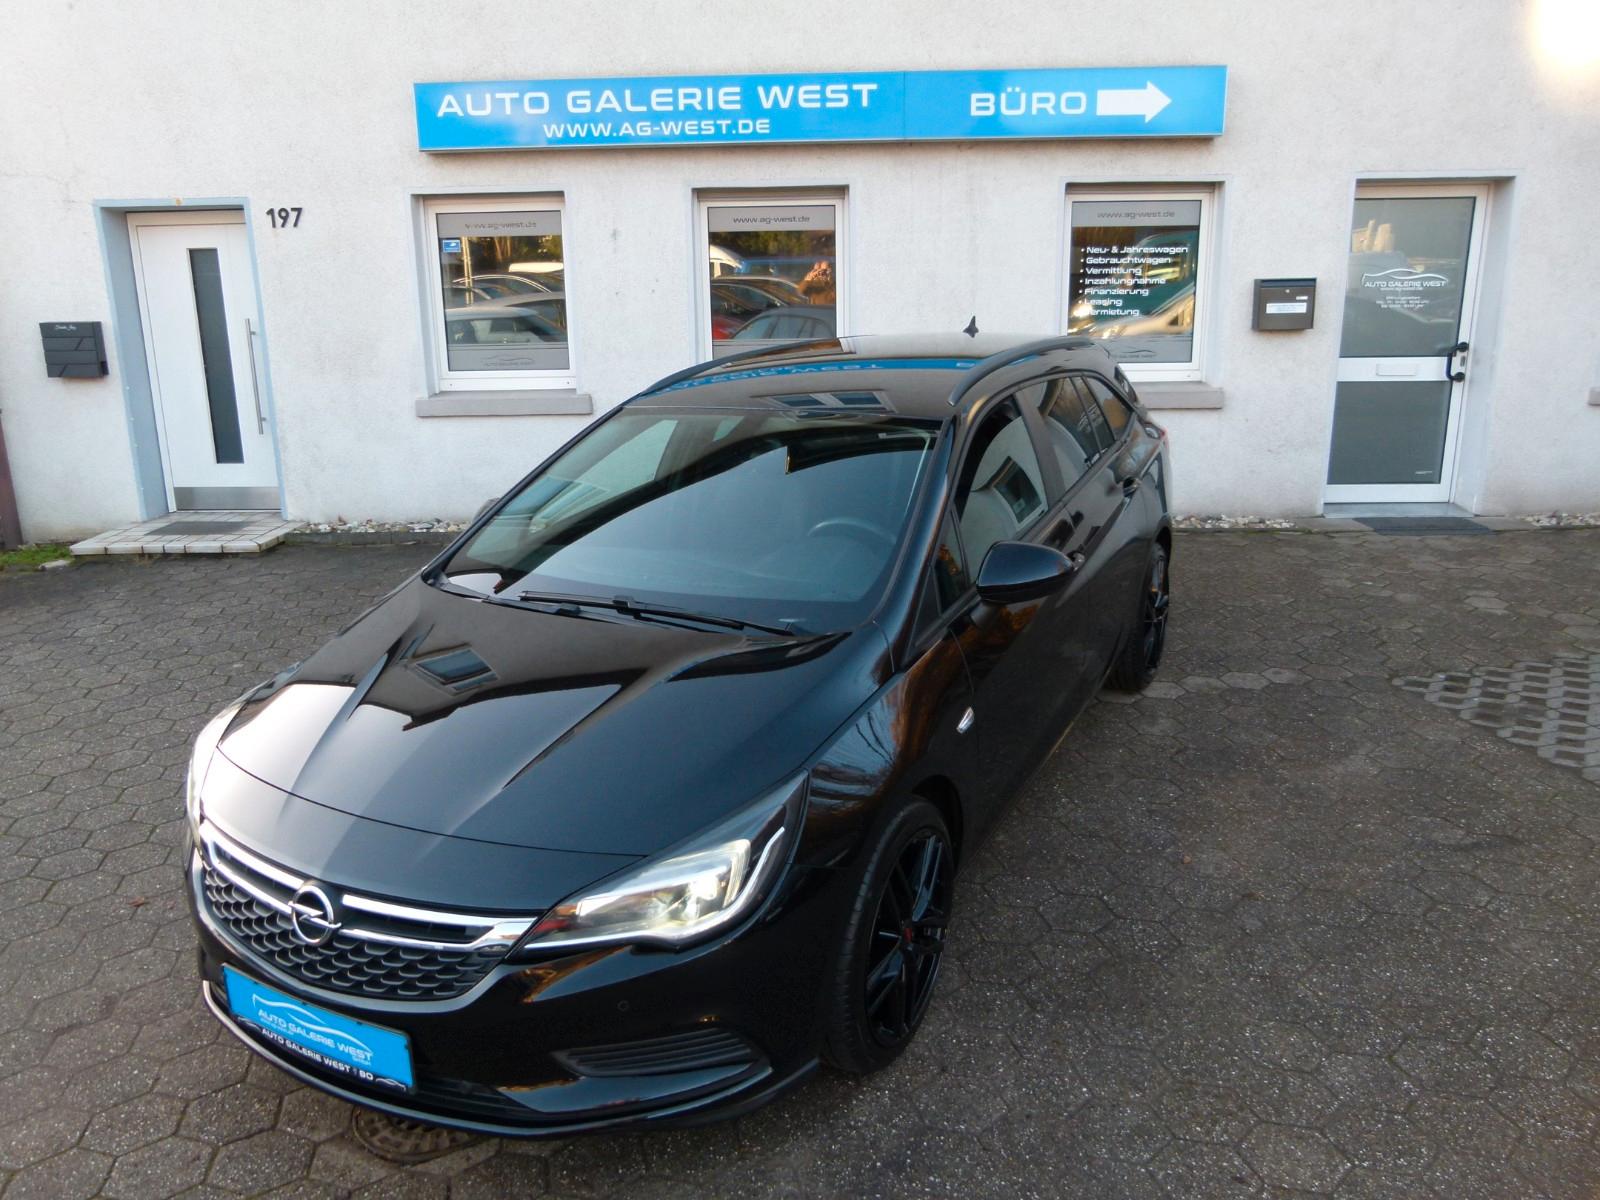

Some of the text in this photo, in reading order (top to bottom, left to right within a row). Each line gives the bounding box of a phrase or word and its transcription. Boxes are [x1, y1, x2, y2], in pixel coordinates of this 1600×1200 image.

[437, 83, 879, 117] AUTO GALERIE WEST
[970, 87, 1087, 117] BÜRO
[543, 118, 771, 139] WWW.AG-WEST.DE
[266, 207, 303, 229] 197
[732, 215, 811, 225] www.ag-west.de
[1097, 210, 1175, 220] www.ag-west.de
[1086, 246, 1189, 255] Neu- & Jahreswagen
[1086, 257, 1171, 265] Gebrauchtwagen
[1085, 267, 1142, 276] Vermittlung
[1084, 278, 1166, 286] Inzahlungnahme
[1365, 280, 1387, 288] AUTO
[1084, 287, 1149, 297] Finanzierung
[1084, 298, 1123, 307] Leasing
[1086, 308, 1140, 317] ermietung
[257, 1008, 287, 1029] AUTO
[337, 1041, 374, 1061] WEST
[262, 1028, 285, 1044] AUTO
[323, 1056, 351, 1073] WEST
